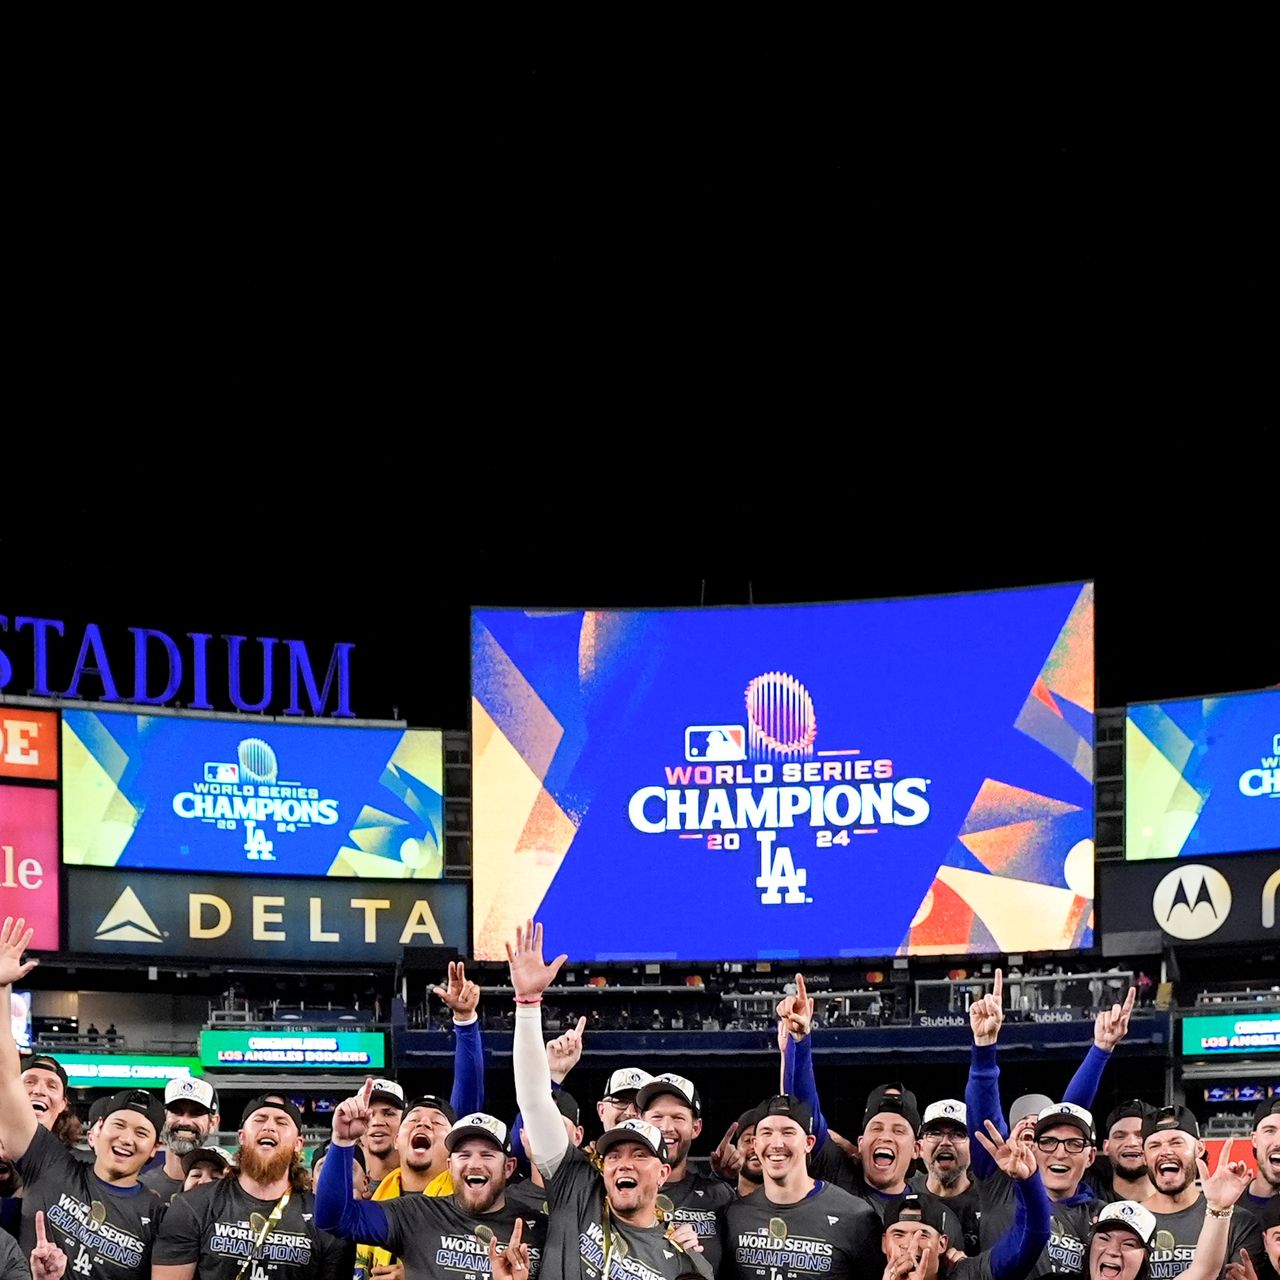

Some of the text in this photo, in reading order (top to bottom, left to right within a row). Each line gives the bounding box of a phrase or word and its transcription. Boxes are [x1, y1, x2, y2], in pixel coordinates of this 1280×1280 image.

[665, 759, 894, 785] WORLD SERIES
[194, 782, 318, 799] WORLD SERIES
[172, 791, 339, 825] CHAMPIONS
[628, 777, 930, 833] CHAMPIONS
[216, 819, 237, 830] 20
[244, 820, 274, 861] LA
[707, 829, 850, 850] 20 24
[756, 830, 811, 904] LA
[188, 892, 444, 945] DELTA
[919, 1015, 966, 1027] StubHub
[1201, 1037, 1227, 1049] LOS
[217, 1051, 368, 1063] LOS ANGELES DODGERS
[58, 1193, 146, 1253] WORLD SERIES
[47, 1204, 144, 1268] CHAMPIONS
[738, 1234, 833, 1256] WORLD SERIES
[736, 1247, 832, 1272] CHAMPIONS
